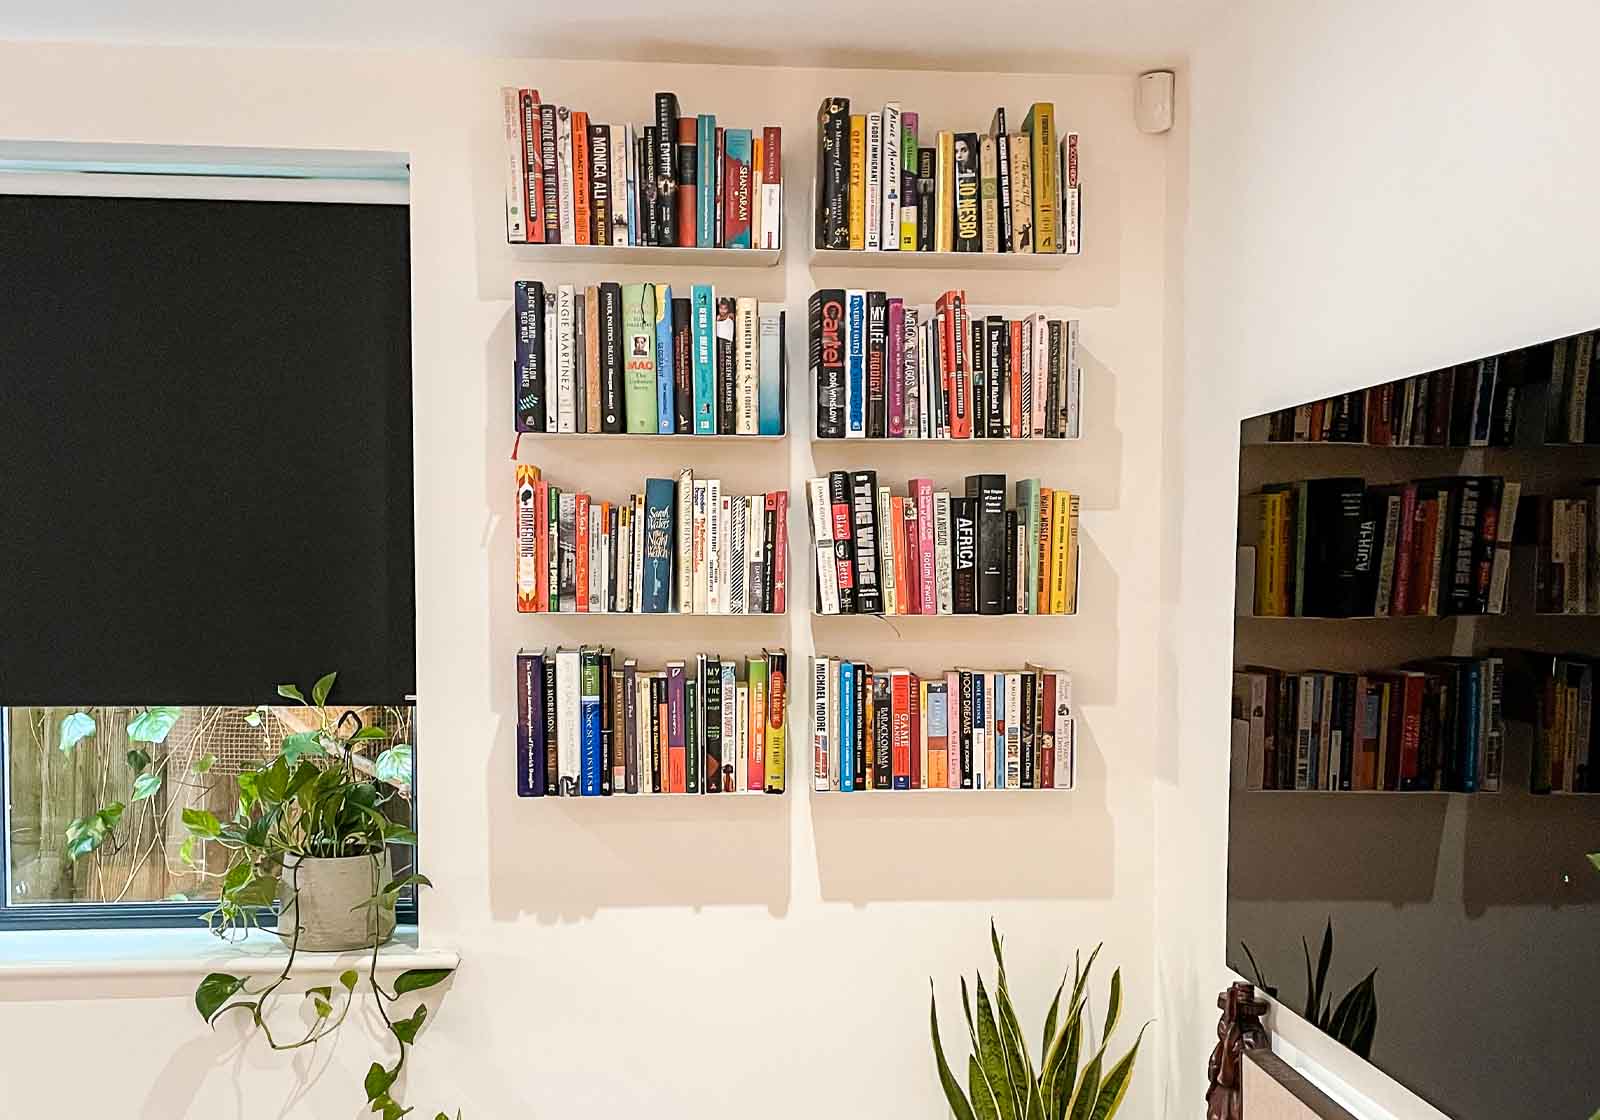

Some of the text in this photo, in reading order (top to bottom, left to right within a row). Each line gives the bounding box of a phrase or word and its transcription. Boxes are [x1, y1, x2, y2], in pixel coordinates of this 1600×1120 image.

[542, 141, 555, 170] OBIOMA
[592, 136, 607, 199] MONICA ALI
[852, 130, 861, 188] OPEN CITY
[871, 144, 879, 183] IMMIGRANT
[544, 174, 557, 229] THE FISHERMEN
[739, 166, 748, 221] SHANTARAM
[959, 181, 977, 239] JO NESBO
[560, 291, 570, 392] ANGIE MARTINEZ
[821, 301, 844, 369] Cartel
[870, 323, 883, 344] LIFE
[904, 310, 916, 351] WELCOME
[991, 330, 999, 341] The
[626, 360, 654, 370] MAO
[905, 359, 915, 386] LAGOS
[829, 388, 837, 423] WINSLOW
[521, 507, 534, 558] HOMEGOING
[854, 483, 876, 585] THE WIRE
[936, 498, 947, 546] MAYA ANGELOU
[959, 518, 973, 569] AFRICA
[1040, 517, 1049, 542] MOSLEY
[839, 560, 849, 586] Betty
[707, 667, 720, 676] MY
[547, 668, 556, 732] TONI MORRISON
[816, 663, 826, 732] MICHAEL MOORE
[963, 672, 971, 734] HOOP DREAMS
[880, 707, 888, 769] BARACK OBAMA
[900, 713, 909, 747] GAME
[1008, 727, 1019, 787] BRICK LANE
